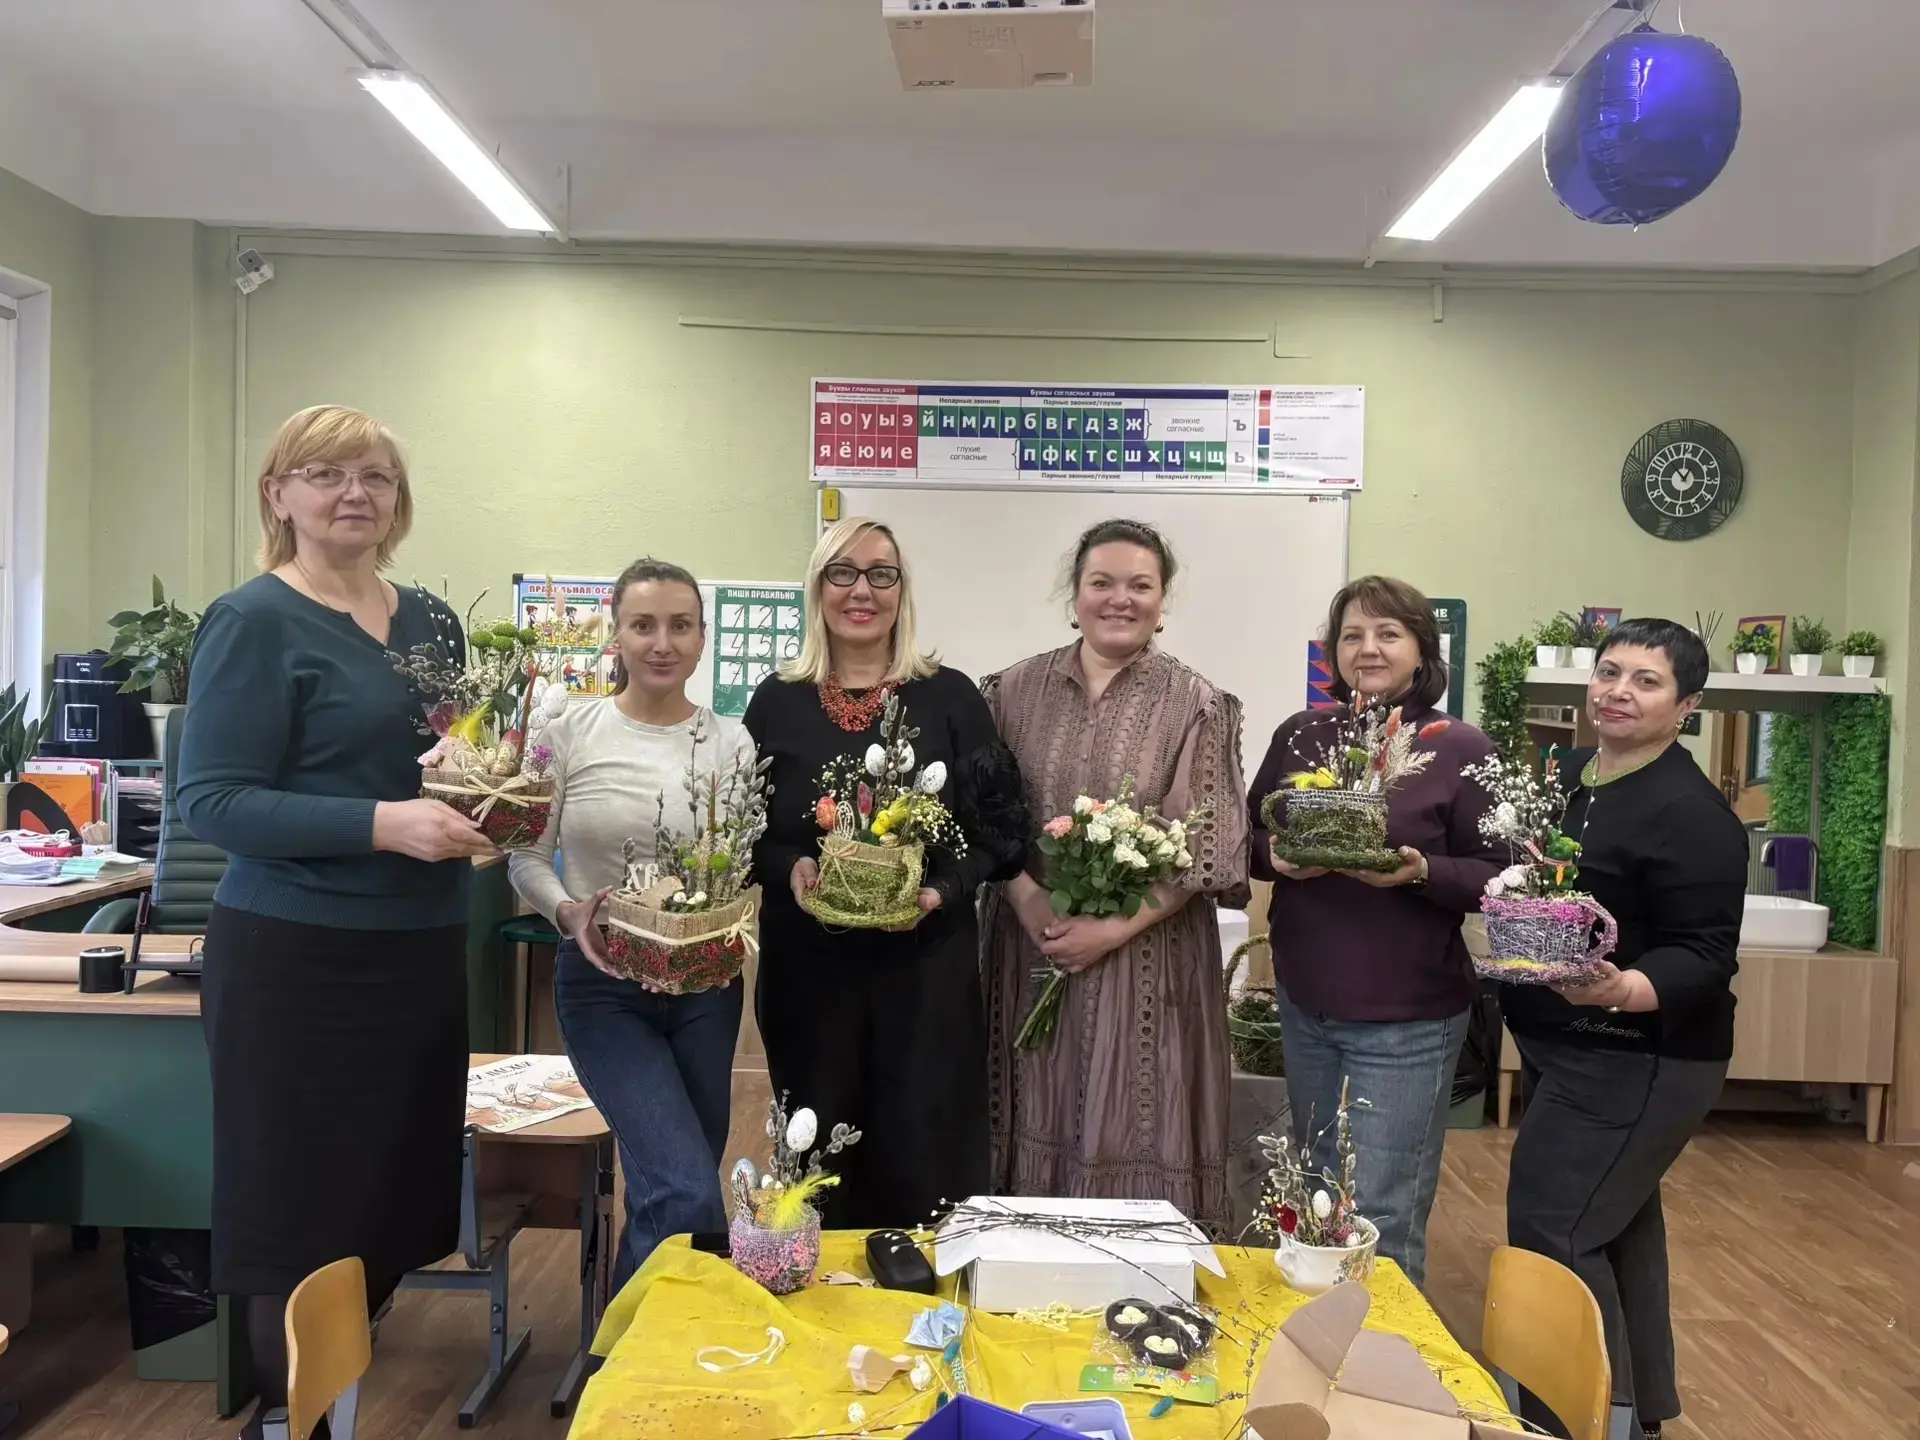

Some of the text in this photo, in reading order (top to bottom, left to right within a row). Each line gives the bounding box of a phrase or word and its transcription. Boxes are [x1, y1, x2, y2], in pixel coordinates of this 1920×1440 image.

[1030, 389, 1052, 397] Буквы
[939, 397, 973, 405] Непарные
[1043, 399, 1122, 407] Парные звонкие/глухие
[820, 412, 913, 430] а о у ы э
[922, 410, 1142, 433] й н м л р б в г д з ж
[1166, 425, 1205, 433] согласные
[820, 442, 913, 459] я ё ю и е
[956, 445, 981, 454] глухие
[1024, 445, 1224, 465] п ф к т с ш х ц ч щ
[1665, 446, 1677, 461] 11
[1679, 443, 1692, 457] 12
[1696, 448, 1705, 460] 1
[949, 453, 988, 461] согласные
[1651, 456, 1666, 471] 10
[1702, 460, 1716, 471] 2
[1041, 472, 1120, 480] Парные звонкие/глухие
[1155, 473, 1189, 481] Непарные
[1646, 474, 1660, 482] 9
[1706, 477, 1719, 485] 3
[1649, 489, 1662, 499] 8
[1701, 491, 1713, 501] 4
[1661, 497, 1671, 511] 7
[1676, 503, 1683, 516] 6
[1690, 499, 1700, 513] 5
[529, 585, 591, 594] ПРАИЛЬНАЯ
[727, 589, 795, 600] ПИШИ ПРАВИЛЬНО
[734, 605, 801, 630] 1 2 3
[731, 633, 800, 659] 4 5 6
[729, 661, 772, 686] 7 8
